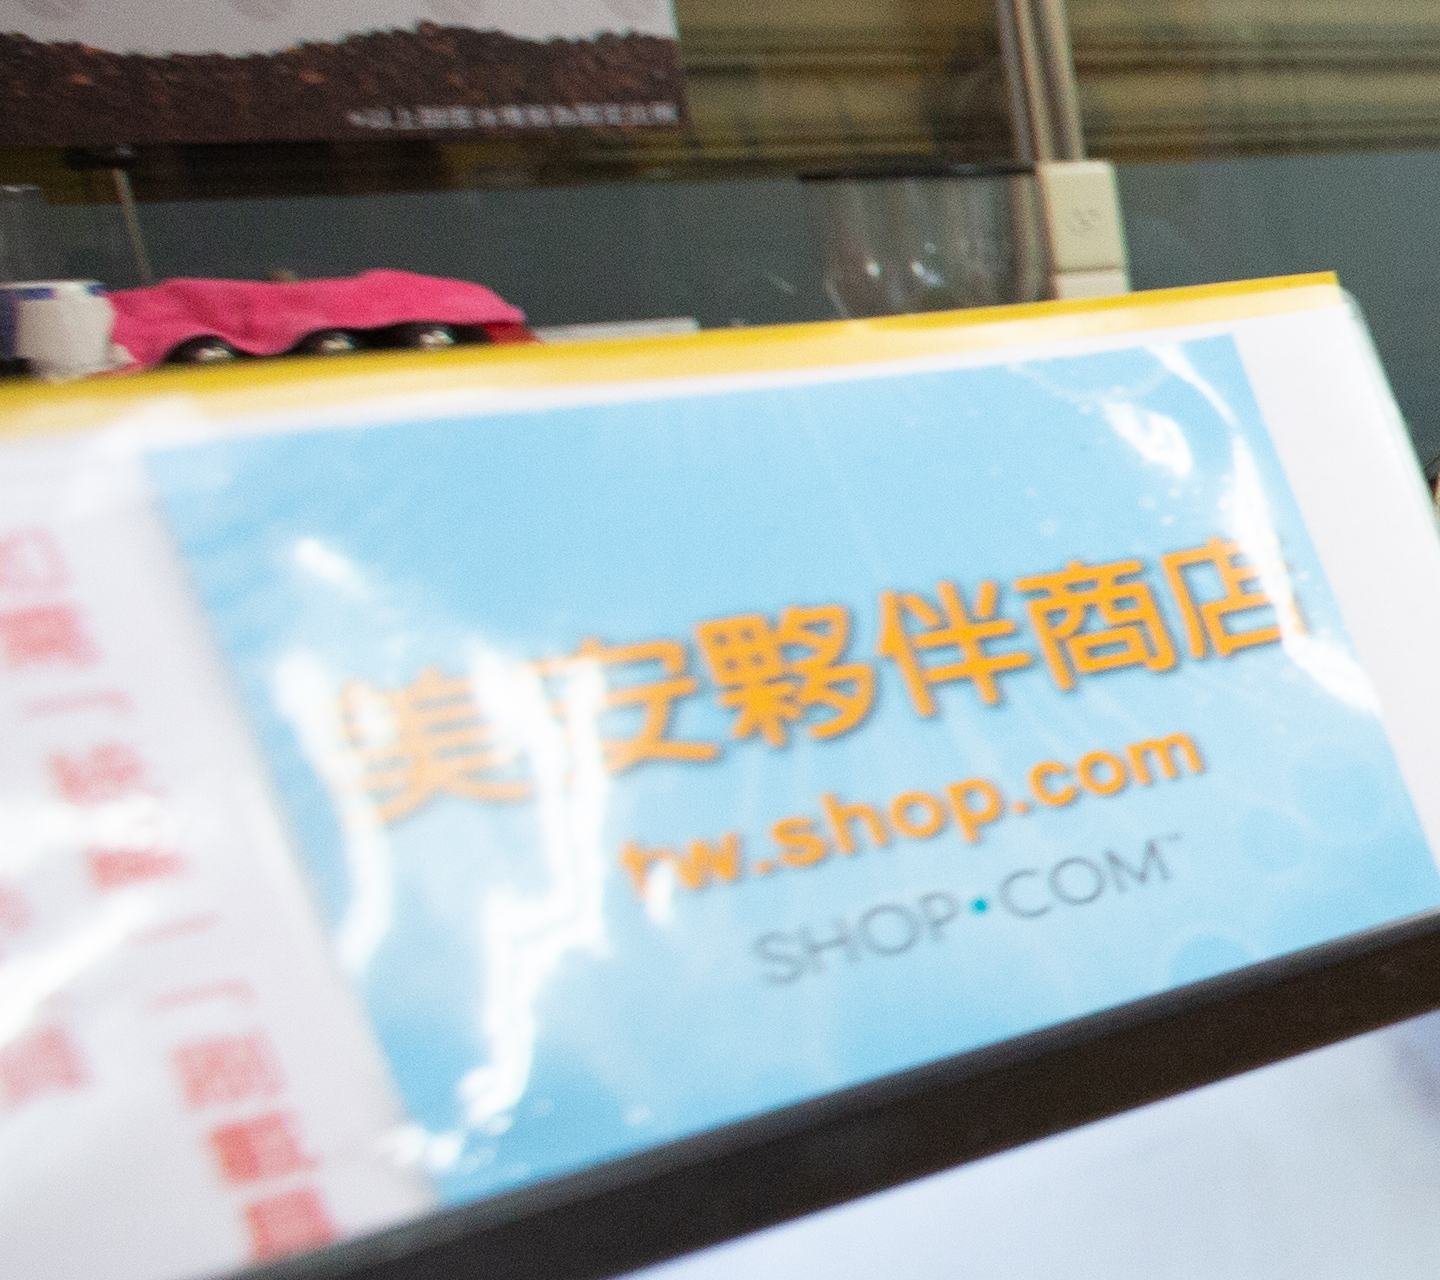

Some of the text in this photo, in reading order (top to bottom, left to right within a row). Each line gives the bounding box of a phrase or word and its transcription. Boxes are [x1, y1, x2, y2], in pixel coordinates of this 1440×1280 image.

[338, 538, 1308, 830] 美安夥伴商店
[623, 728, 1205, 899] tw.shop.com
